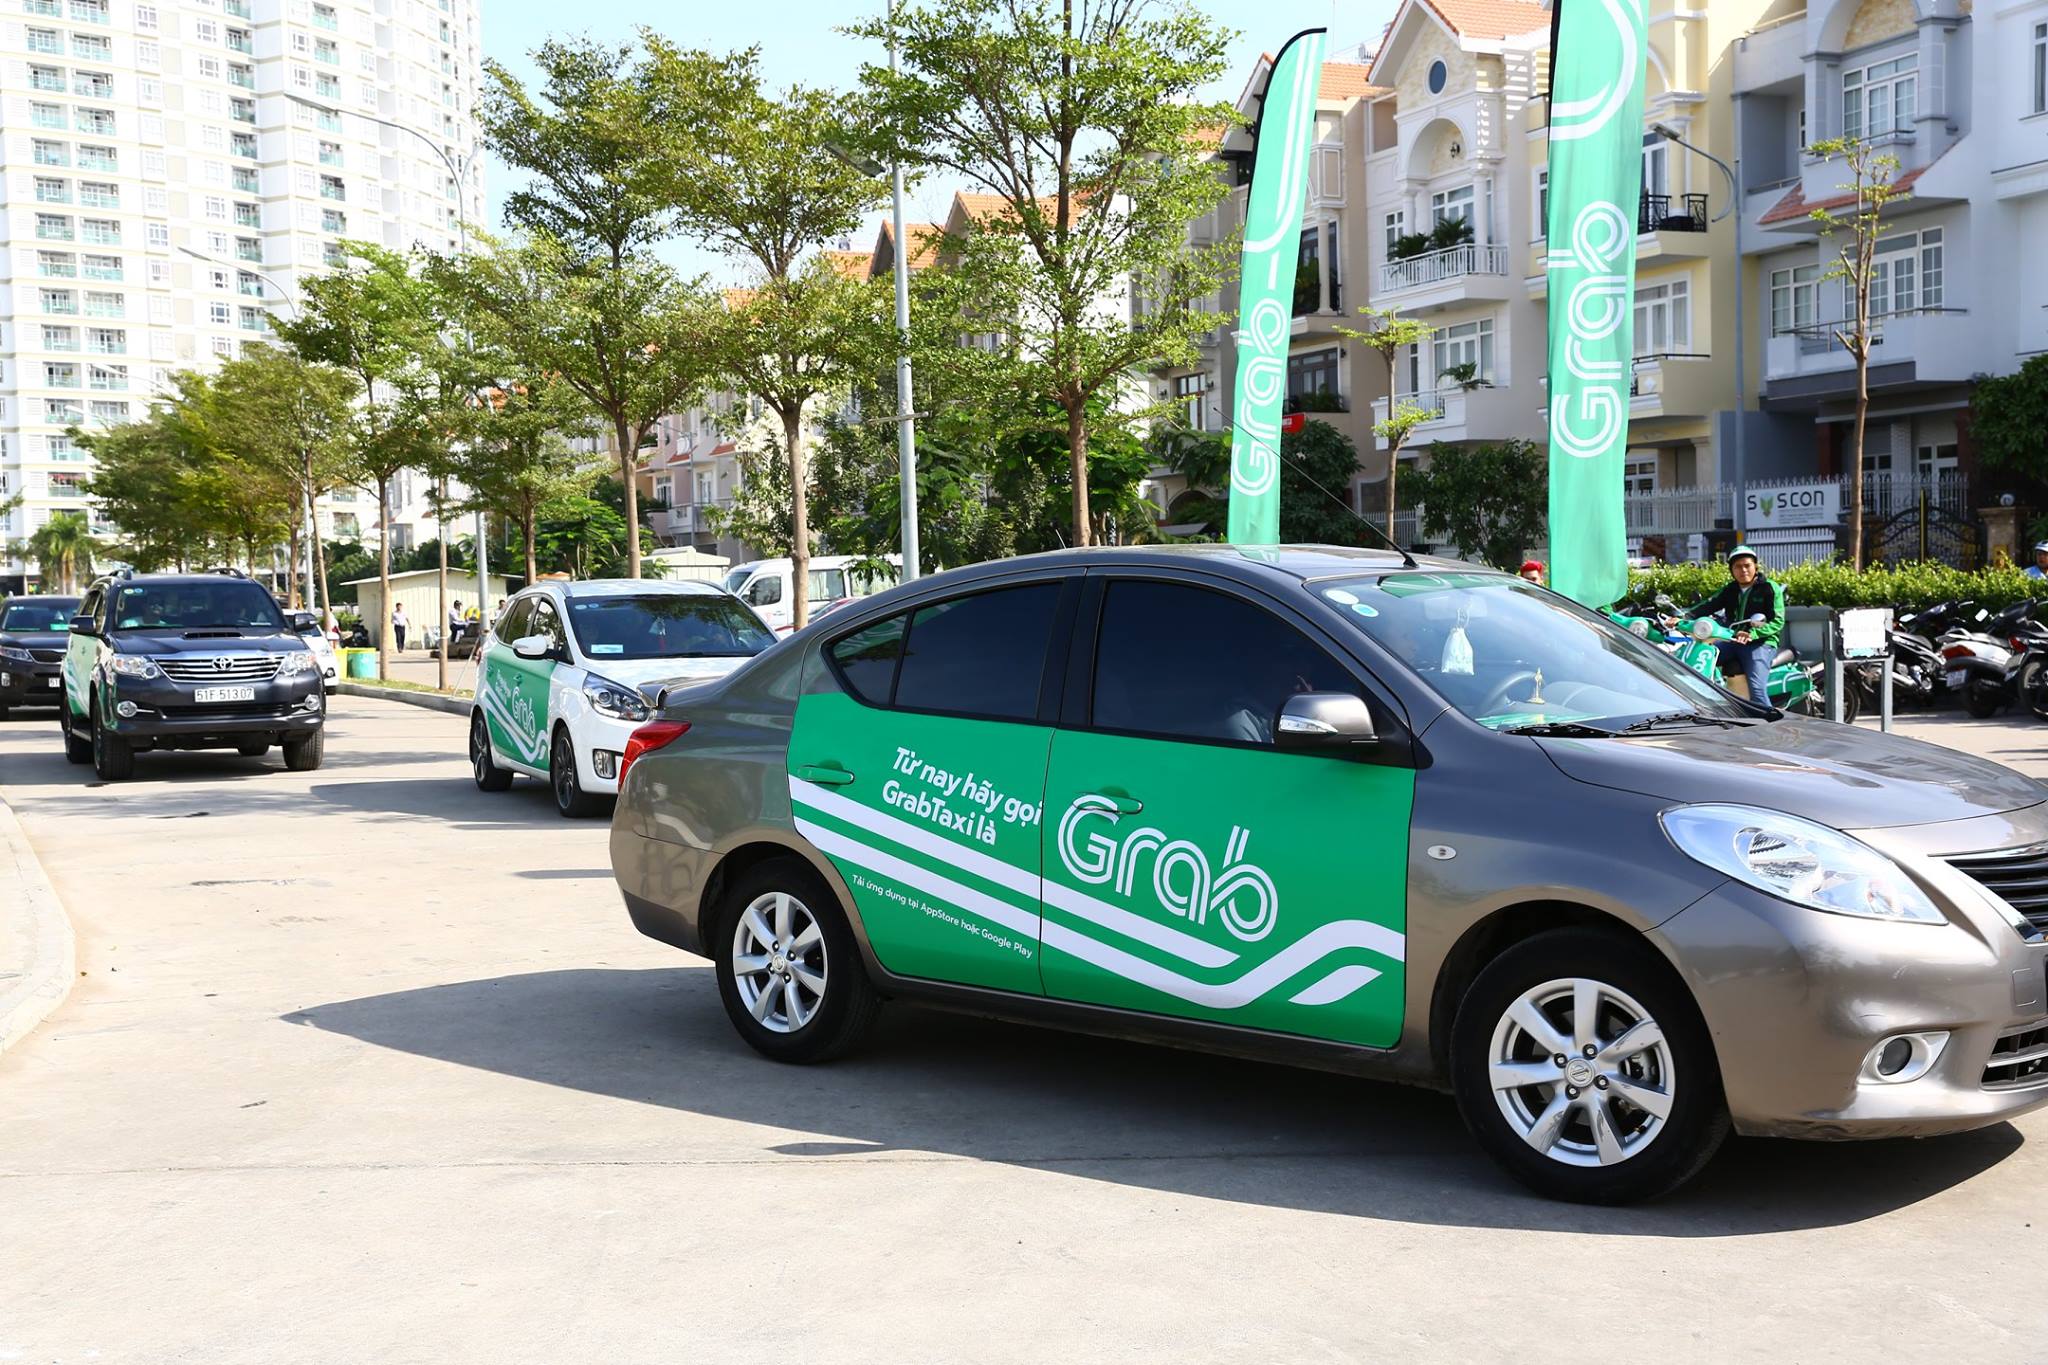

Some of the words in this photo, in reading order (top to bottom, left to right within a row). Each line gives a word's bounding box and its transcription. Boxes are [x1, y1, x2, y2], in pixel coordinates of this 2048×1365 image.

[1547, 200, 1630, 458] Grab
[1230, 297, 1288, 497] Grab
[512, 686, 536, 739] Grab
[882, 779, 976, 837] GrabTaxi
[975, 814, 997, 846] là
[892, 746, 923, 776] Từ
[919, 764, 962, 797] nay
[960, 772, 1004, 814] hãy
[1003, 796, 1044, 828] gọi
[1057, 794, 1279, 942] Grab
[920, 903, 960, 926] AppStore
[981, 928, 1012, 949] Google
[1013, 941, 1033, 959] Play
